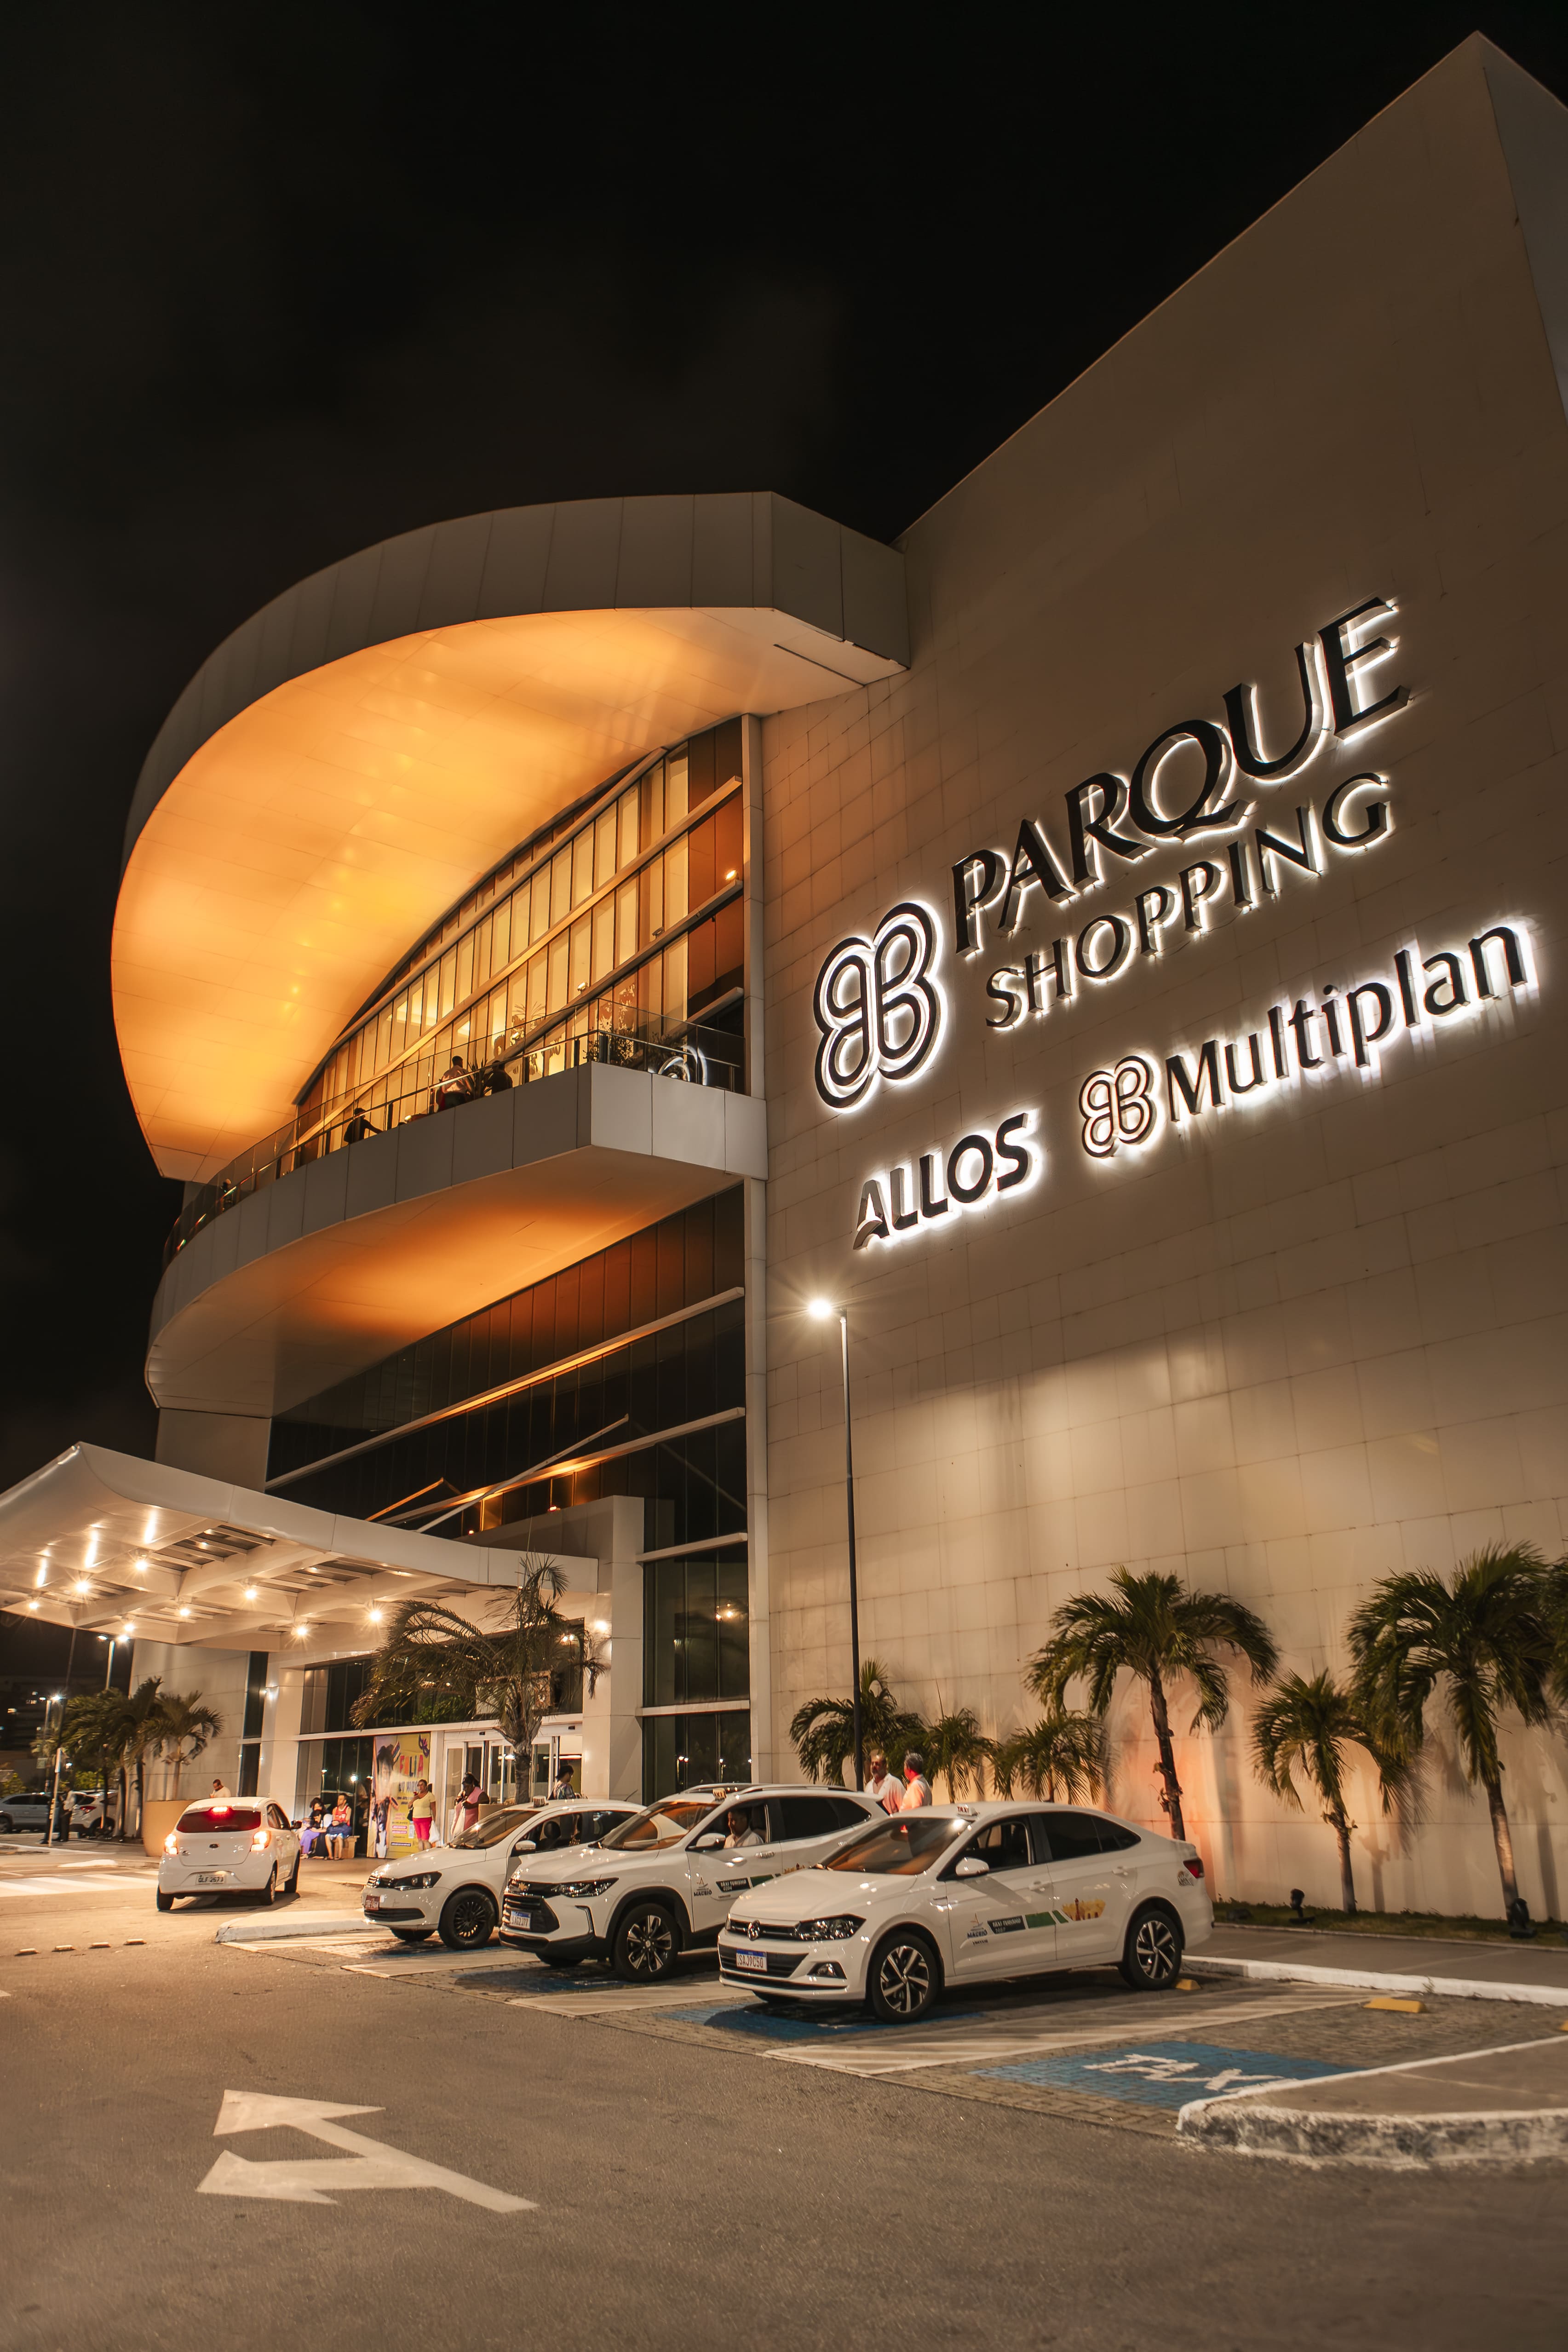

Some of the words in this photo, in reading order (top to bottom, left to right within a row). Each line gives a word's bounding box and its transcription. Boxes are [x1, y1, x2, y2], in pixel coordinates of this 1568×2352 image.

[952, 597, 1410, 957] PARQUE
[985, 772, 1390, 1030] SHOPPING
[1165, 926, 1528, 1123] Multiplan
[852, 1112, 1033, 1250] ALLOS
[739, 1954, 764, 1968] SAJ9C50
